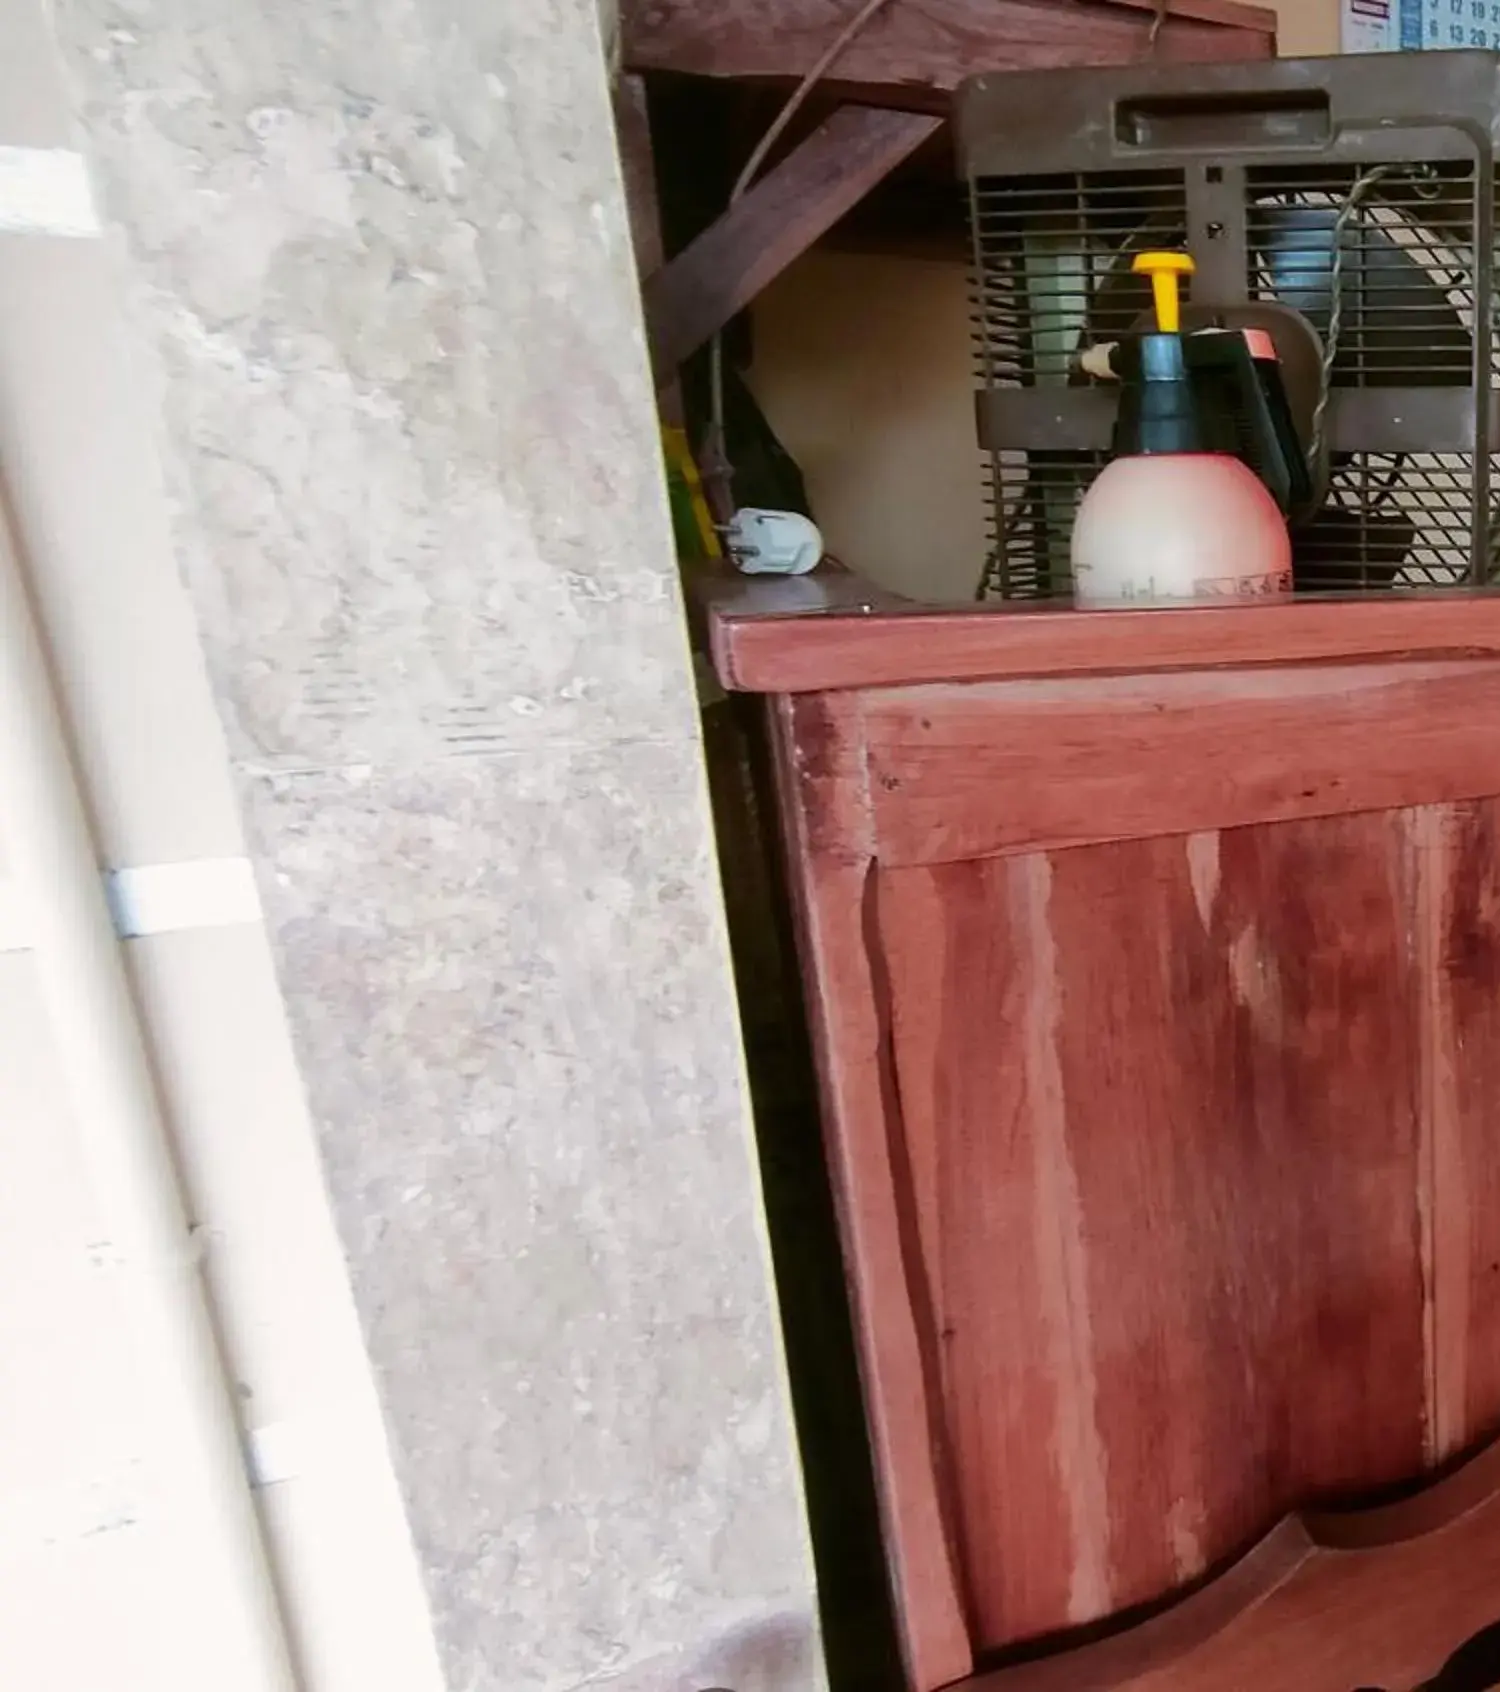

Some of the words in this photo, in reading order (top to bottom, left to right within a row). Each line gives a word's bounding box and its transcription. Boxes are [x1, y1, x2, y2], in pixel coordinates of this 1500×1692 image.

[1450, 0, 1463, 14] 12
[1430, 19, 1439, 37] 6
[1449, 25, 1463, 42] 13
[1470, 28, 1486, 47] 20
